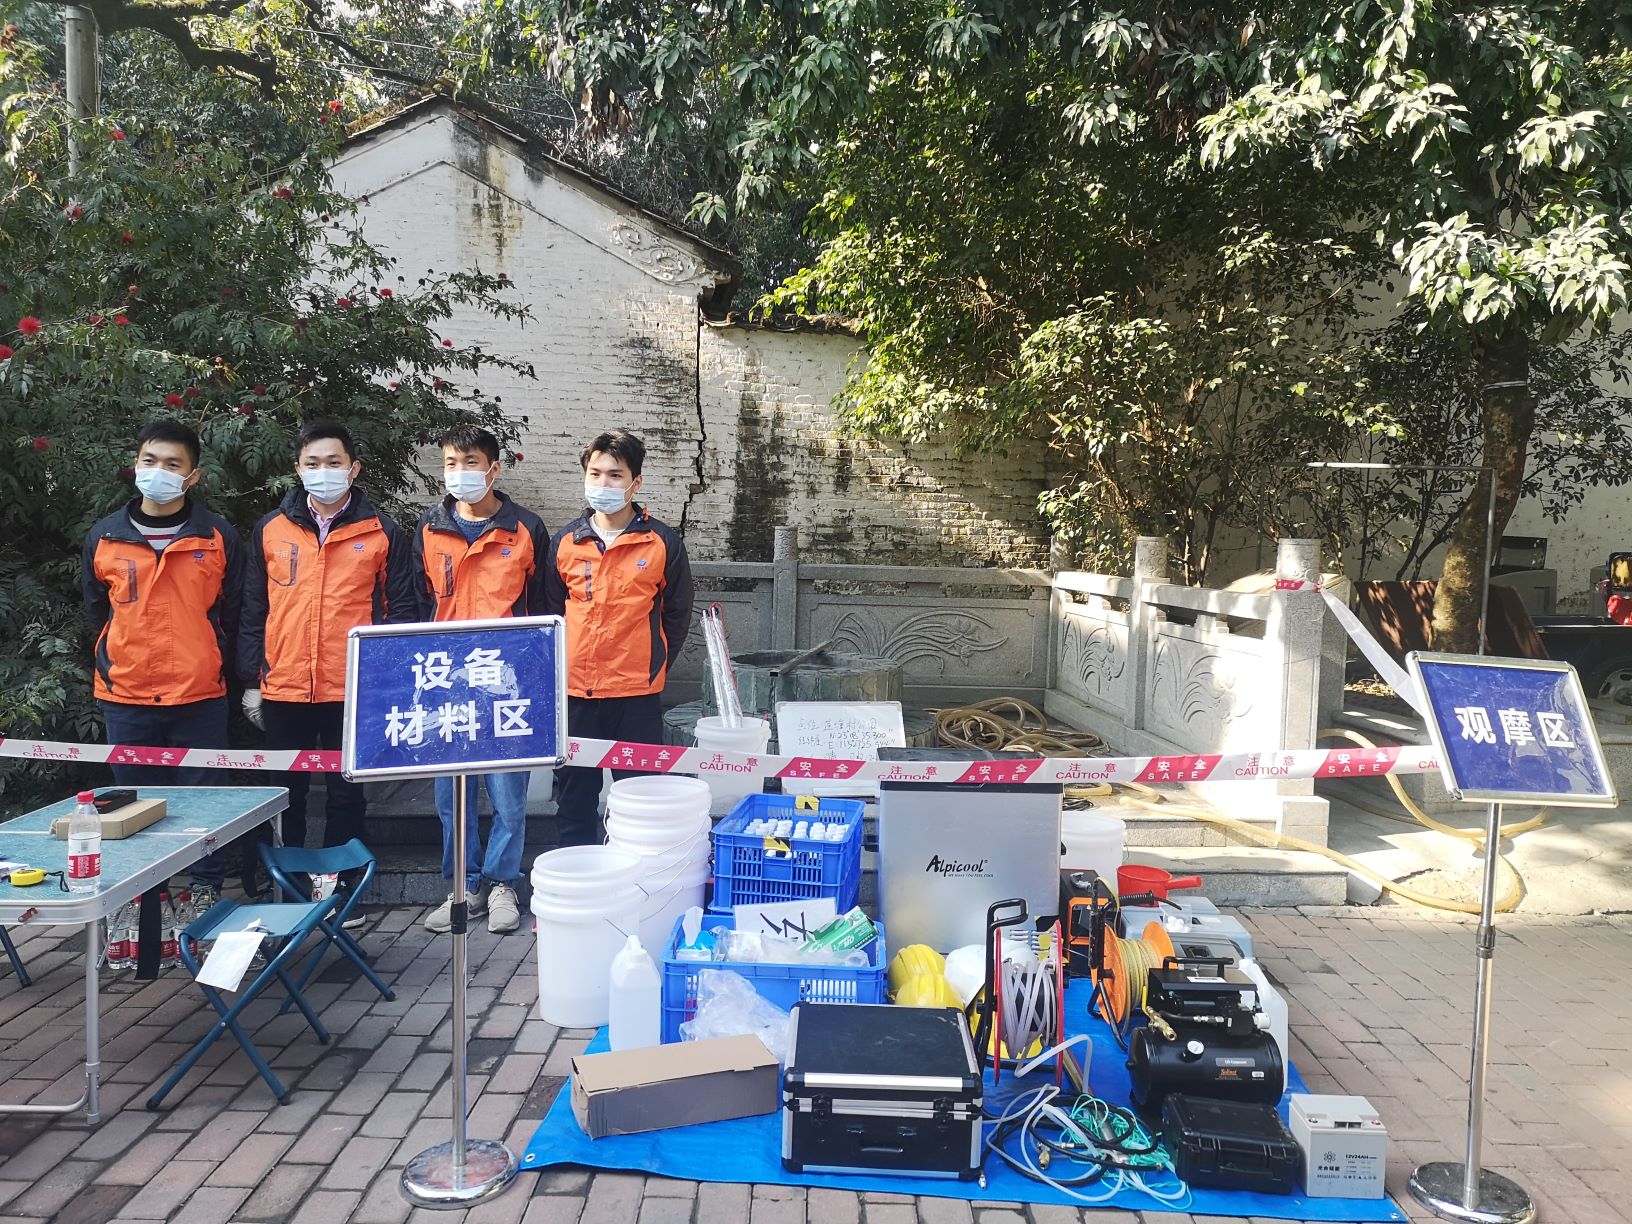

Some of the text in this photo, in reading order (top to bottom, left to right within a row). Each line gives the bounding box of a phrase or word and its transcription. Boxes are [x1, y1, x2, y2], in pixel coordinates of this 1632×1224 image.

[411, 647, 505, 691] 设备
[384, 698, 534, 747] 材料区
[1454, 706, 1575, 749] 观摩区
[32, 744, 81, 755] 注意
[569, 742, 580, 753] 意
[621, 746, 671, 760] 安全
[22, 751, 79, 759] CAUTION
[117, 755, 171, 765] SAFE
[123, 749, 175, 760] 安全
[217, 753, 266, 762] 注意
[308, 754, 321, 762] 安
[712, 753, 759, 767] 注意
[1337, 752, 1388, 764] 安全
[206, 760, 263, 768] CAUTION
[611, 756, 662, 768] SAFE
[1157, 758, 1207, 772] 安全
[1247, 755, 1295, 767] 注意
[699, 762, 752, 772] CAUTION
[799, 761, 849, 773] 安全
[891, 765, 938, 775] 注意
[979, 763, 1028, 775] 安全
[1069, 762, 1116, 772] 注意
[1235, 766, 1289, 776] CAUTION
[1328, 763, 1381, 774] SAFE
[789, 770, 840, 779] SAFE
[1056, 771, 1110, 779] CAUTION
[1147, 771, 1199, 780] SAFE
[925, 854, 984, 877] Alpicool
